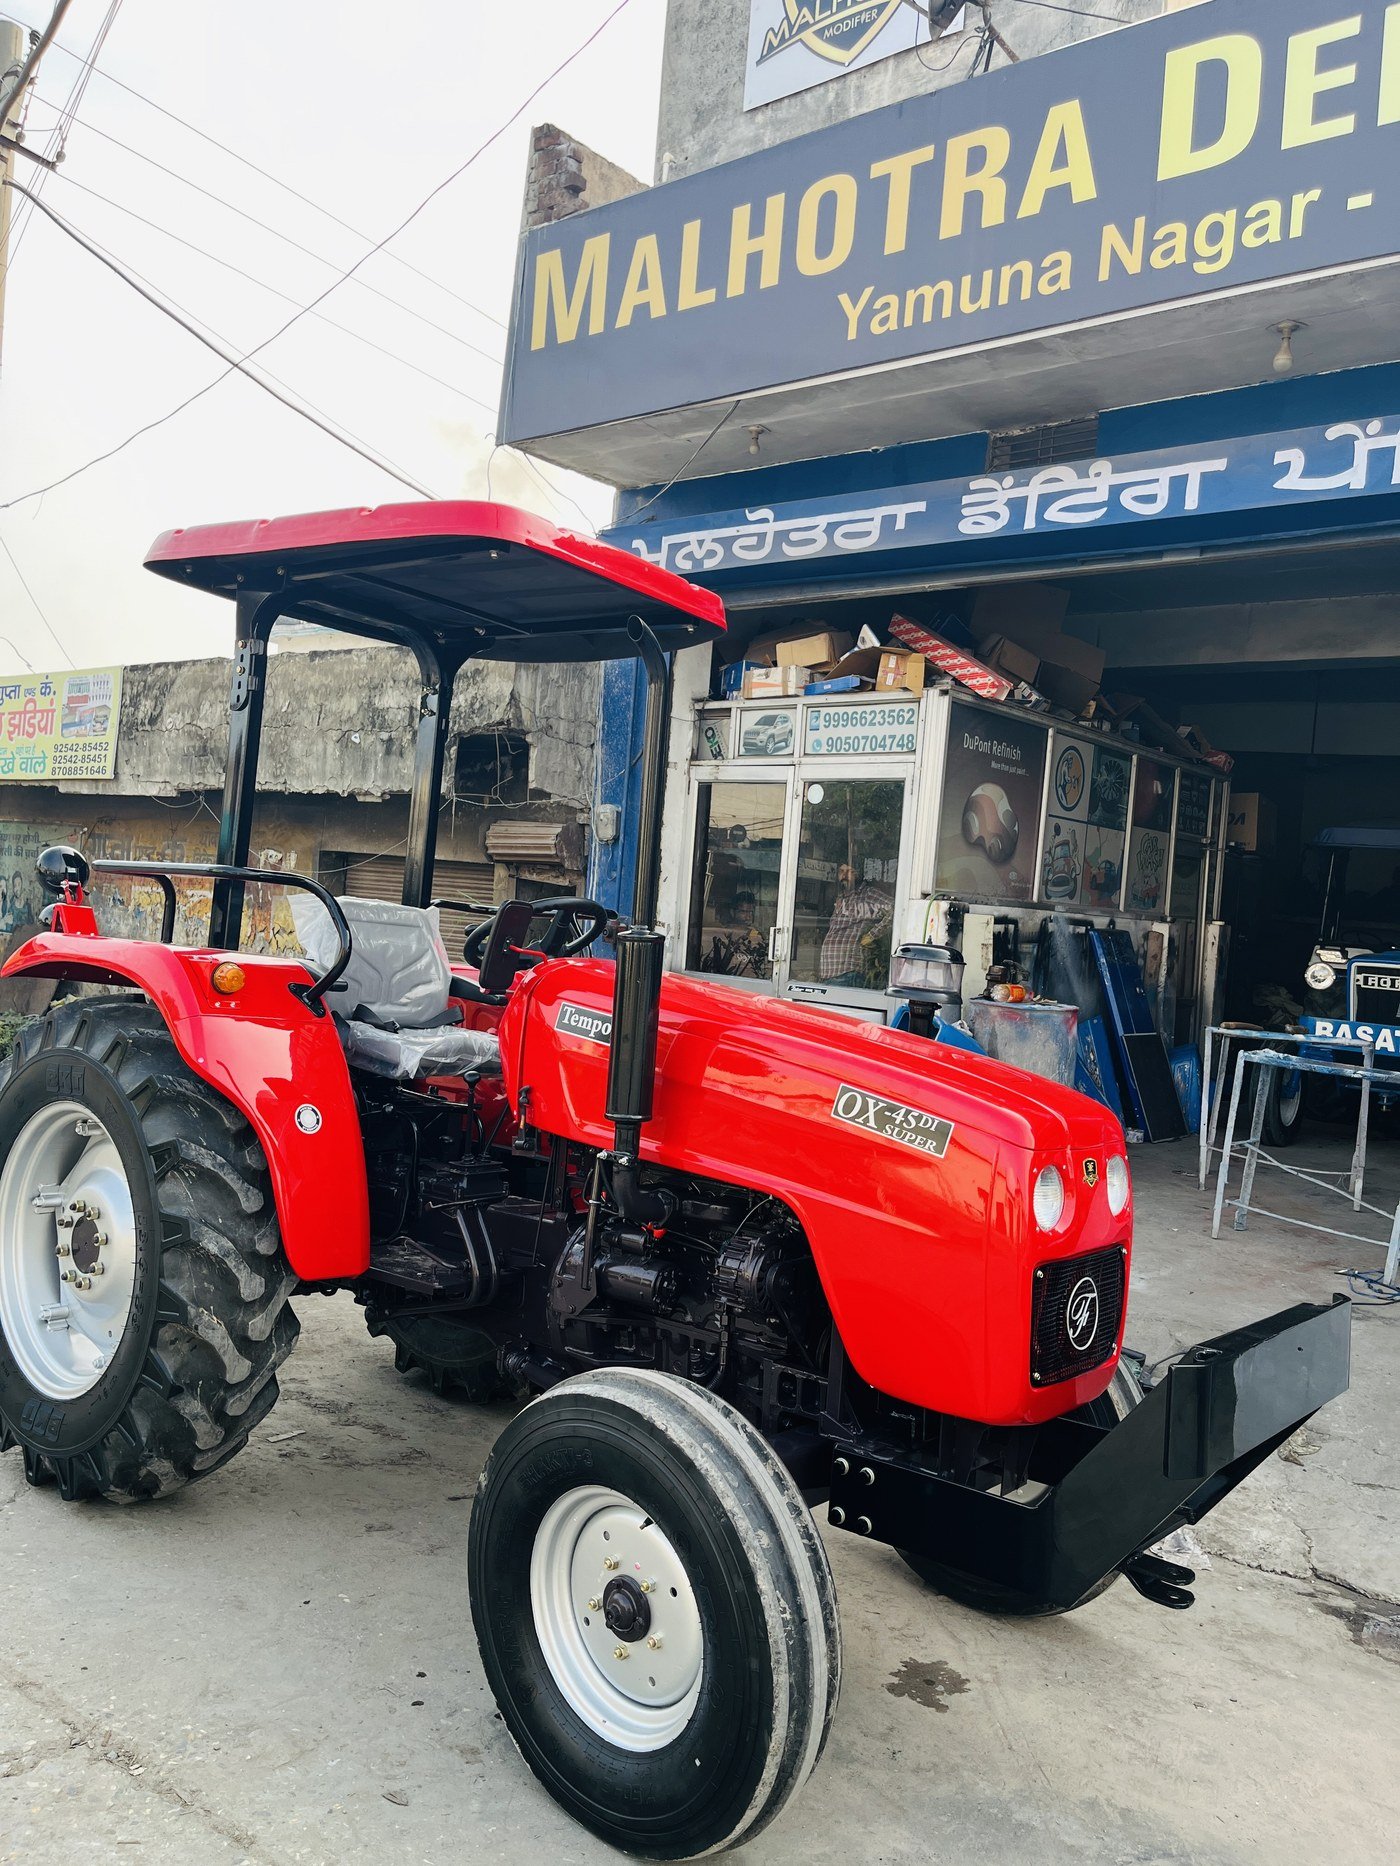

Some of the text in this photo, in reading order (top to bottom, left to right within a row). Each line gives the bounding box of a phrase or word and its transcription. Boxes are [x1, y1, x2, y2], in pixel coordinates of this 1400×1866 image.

[531, 3, 1400, 351] MALHOTRA DE
[838, 250, 1072, 341] Yamuna
[1098, 189, 1321, 281] Nagar
[1273, 420, 1400, 491] ਪੇਂ
[823, 708, 915, 728] 9996623562
[54, 742, 109, 753] 92542-85452
[826, 734, 915, 753] 9050704748
[963, 733, 1021, 760] DuPont Refinish
[53, 754, 107, 765] 92542-85451
[562, 1006, 612, 1037] Tempo
[882, 1124, 938, 1153] SUPER
